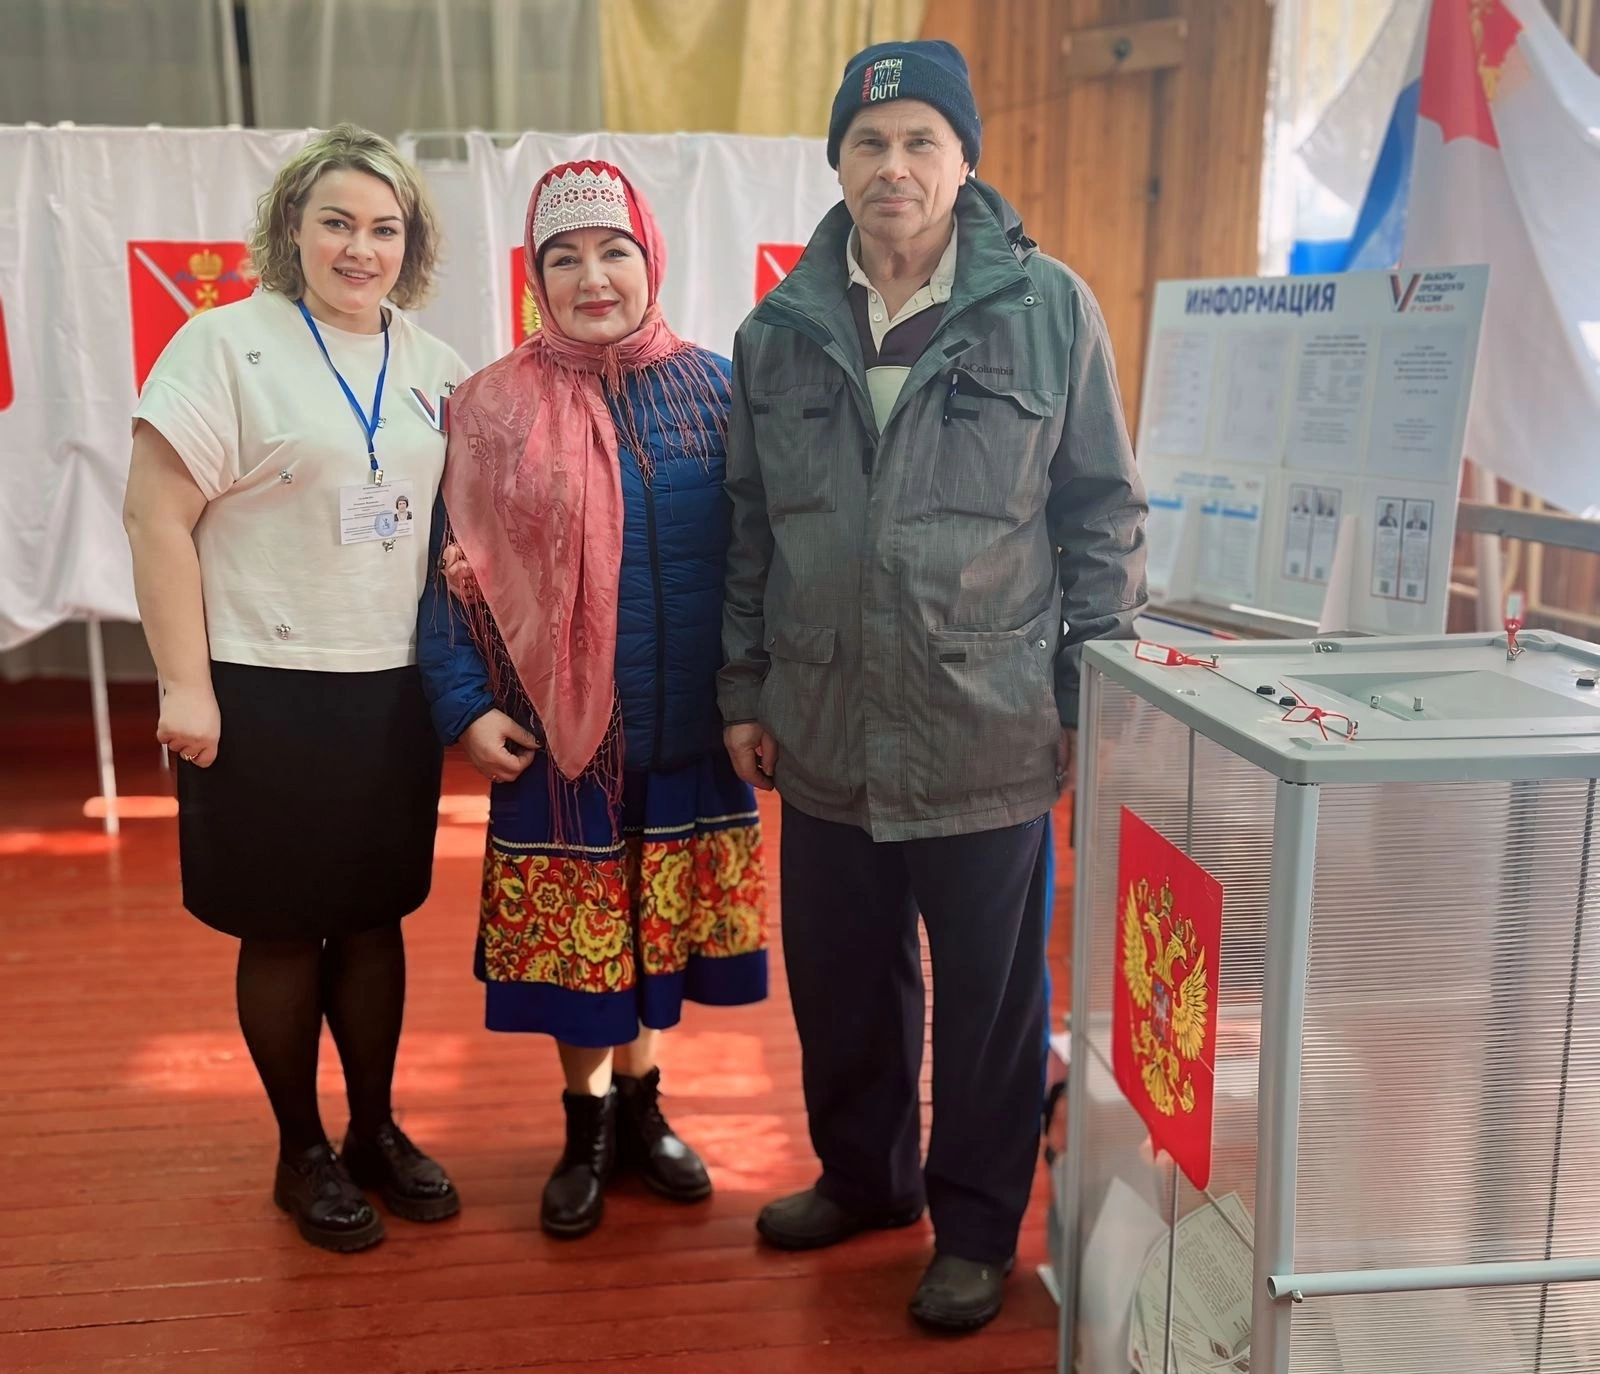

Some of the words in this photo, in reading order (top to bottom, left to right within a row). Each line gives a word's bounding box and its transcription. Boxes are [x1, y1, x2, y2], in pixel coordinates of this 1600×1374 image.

[874, 58, 903, 71] CZECH
[1185, 282, 1336, 316] ИНФОРМАЦИЯ
[970, 363, 1014, 376] Columbia
